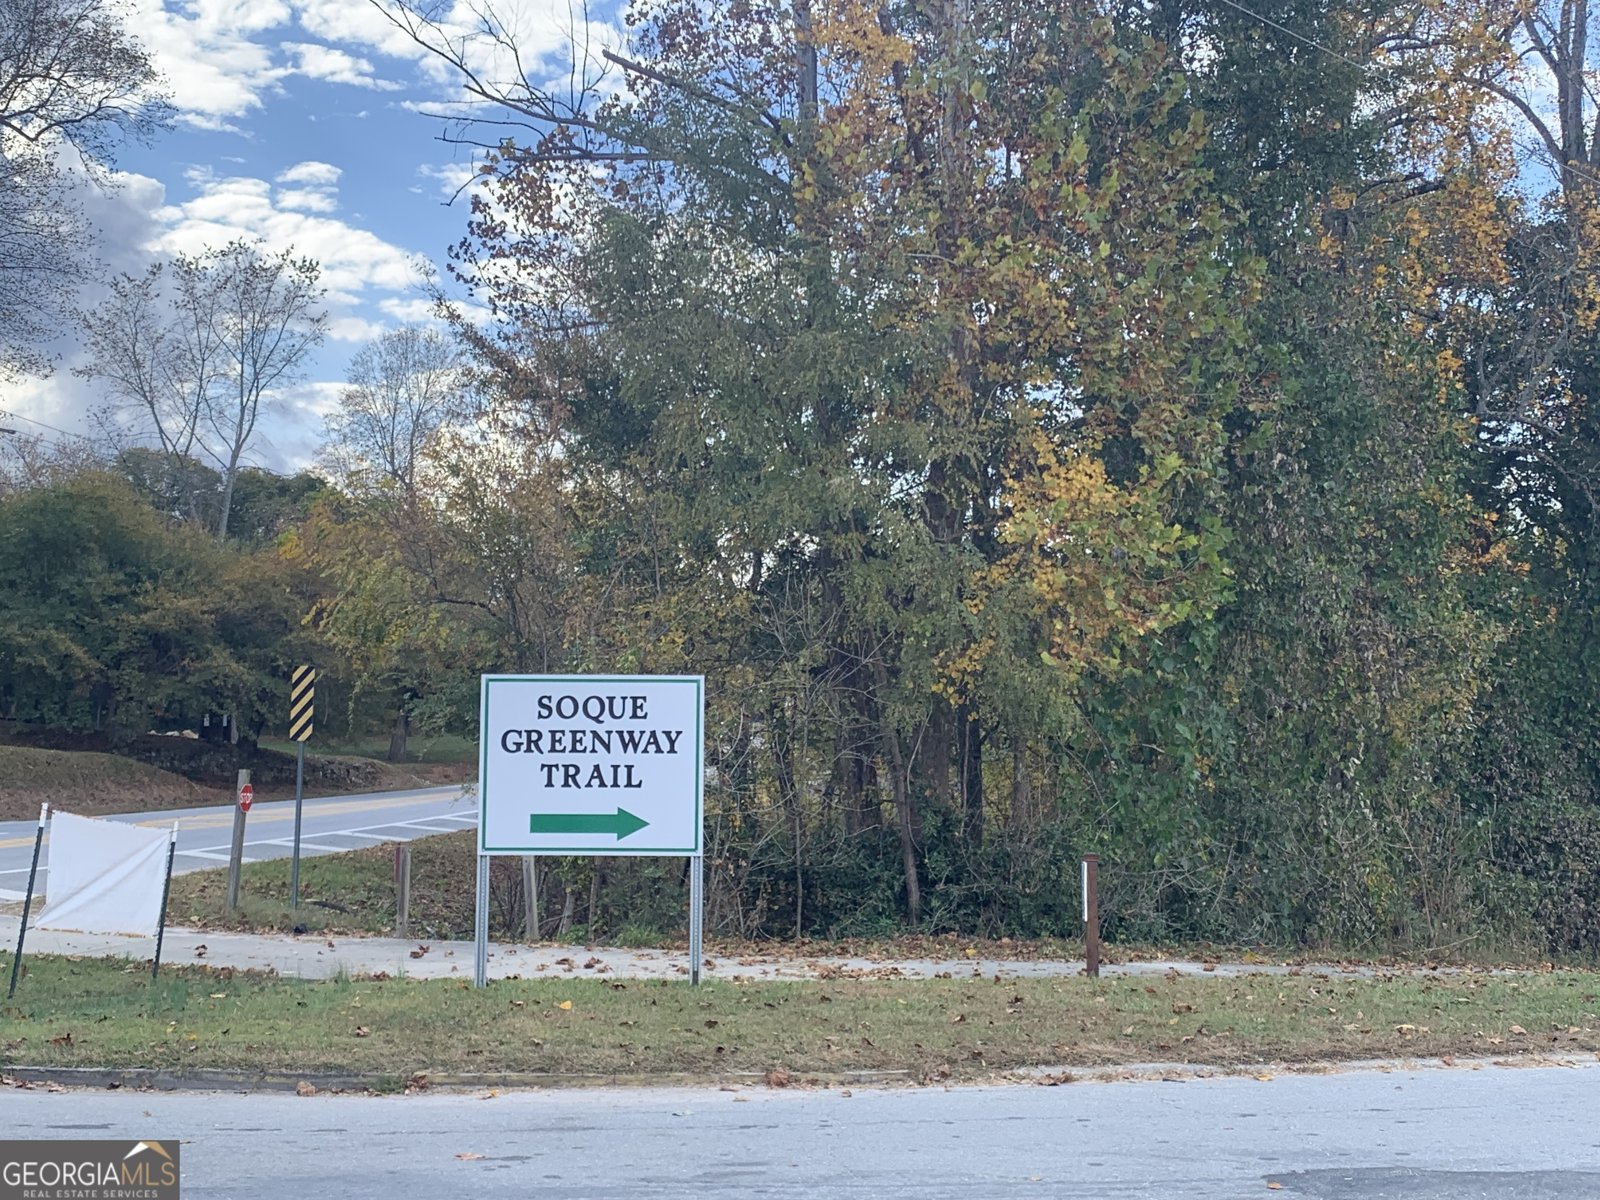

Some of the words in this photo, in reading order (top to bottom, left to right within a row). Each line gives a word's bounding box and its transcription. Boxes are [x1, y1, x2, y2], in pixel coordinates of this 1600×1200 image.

[537, 695, 648, 724] SOQUE
[501, 729, 683, 755] GREENWAY
[540, 763, 643, 789] TRAIL
[240, 792, 253, 804] STOP
